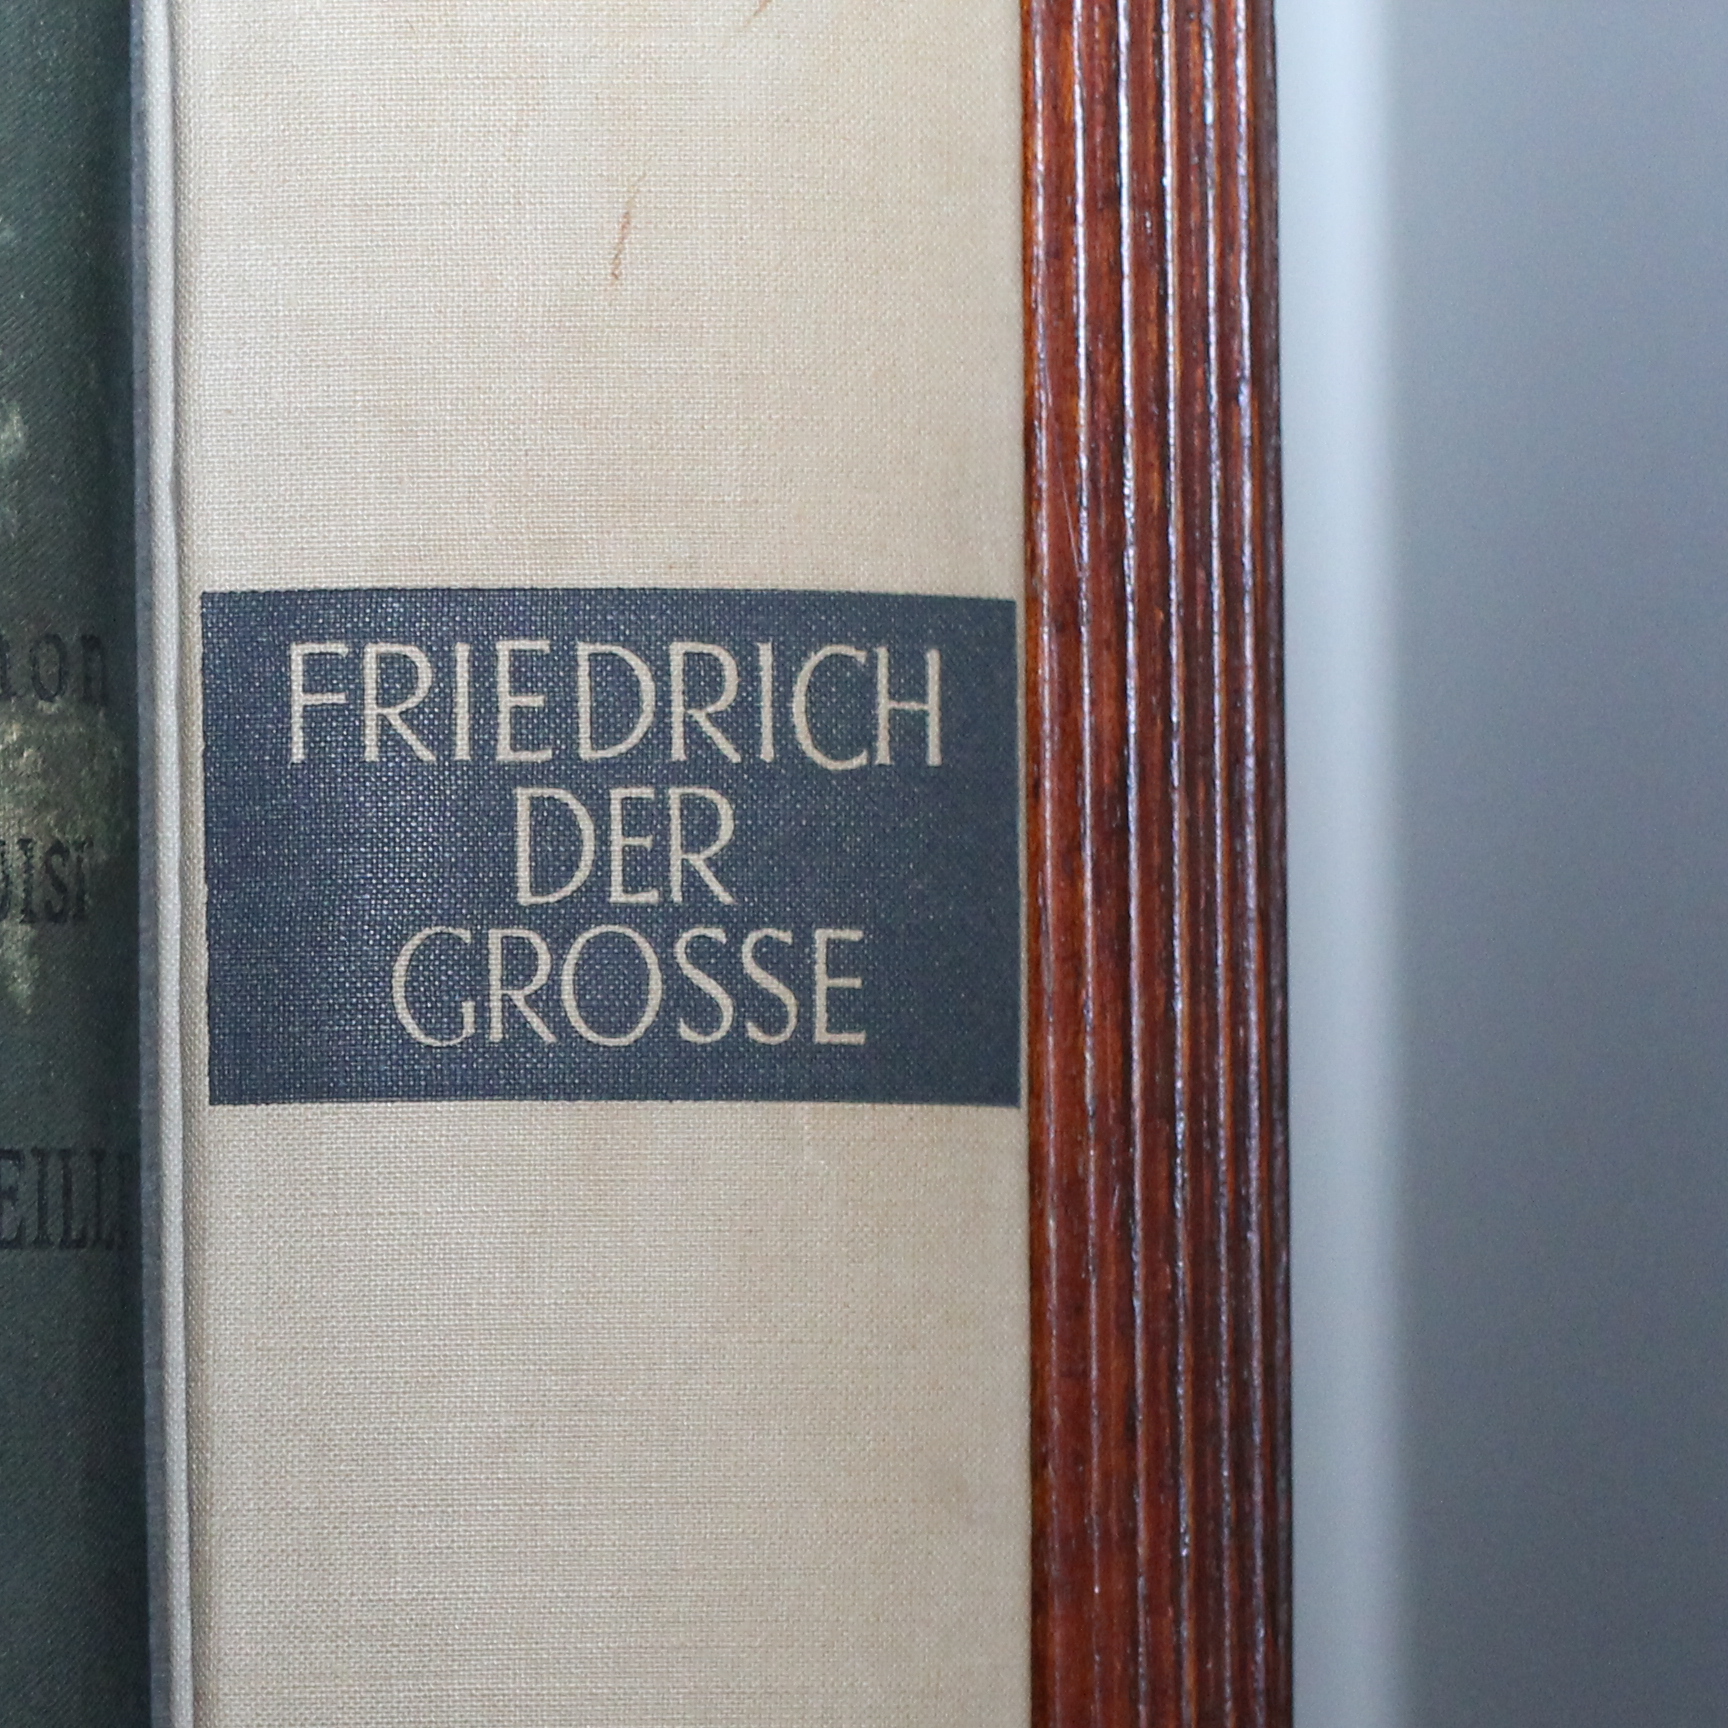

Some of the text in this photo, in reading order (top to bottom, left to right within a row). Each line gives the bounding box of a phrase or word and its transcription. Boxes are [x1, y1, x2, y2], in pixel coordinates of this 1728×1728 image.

[288, 641, 944, 771] FRIEDRICH
[513, 785, 737, 906] DER
[391, 924, 866, 1047] GROSSE
